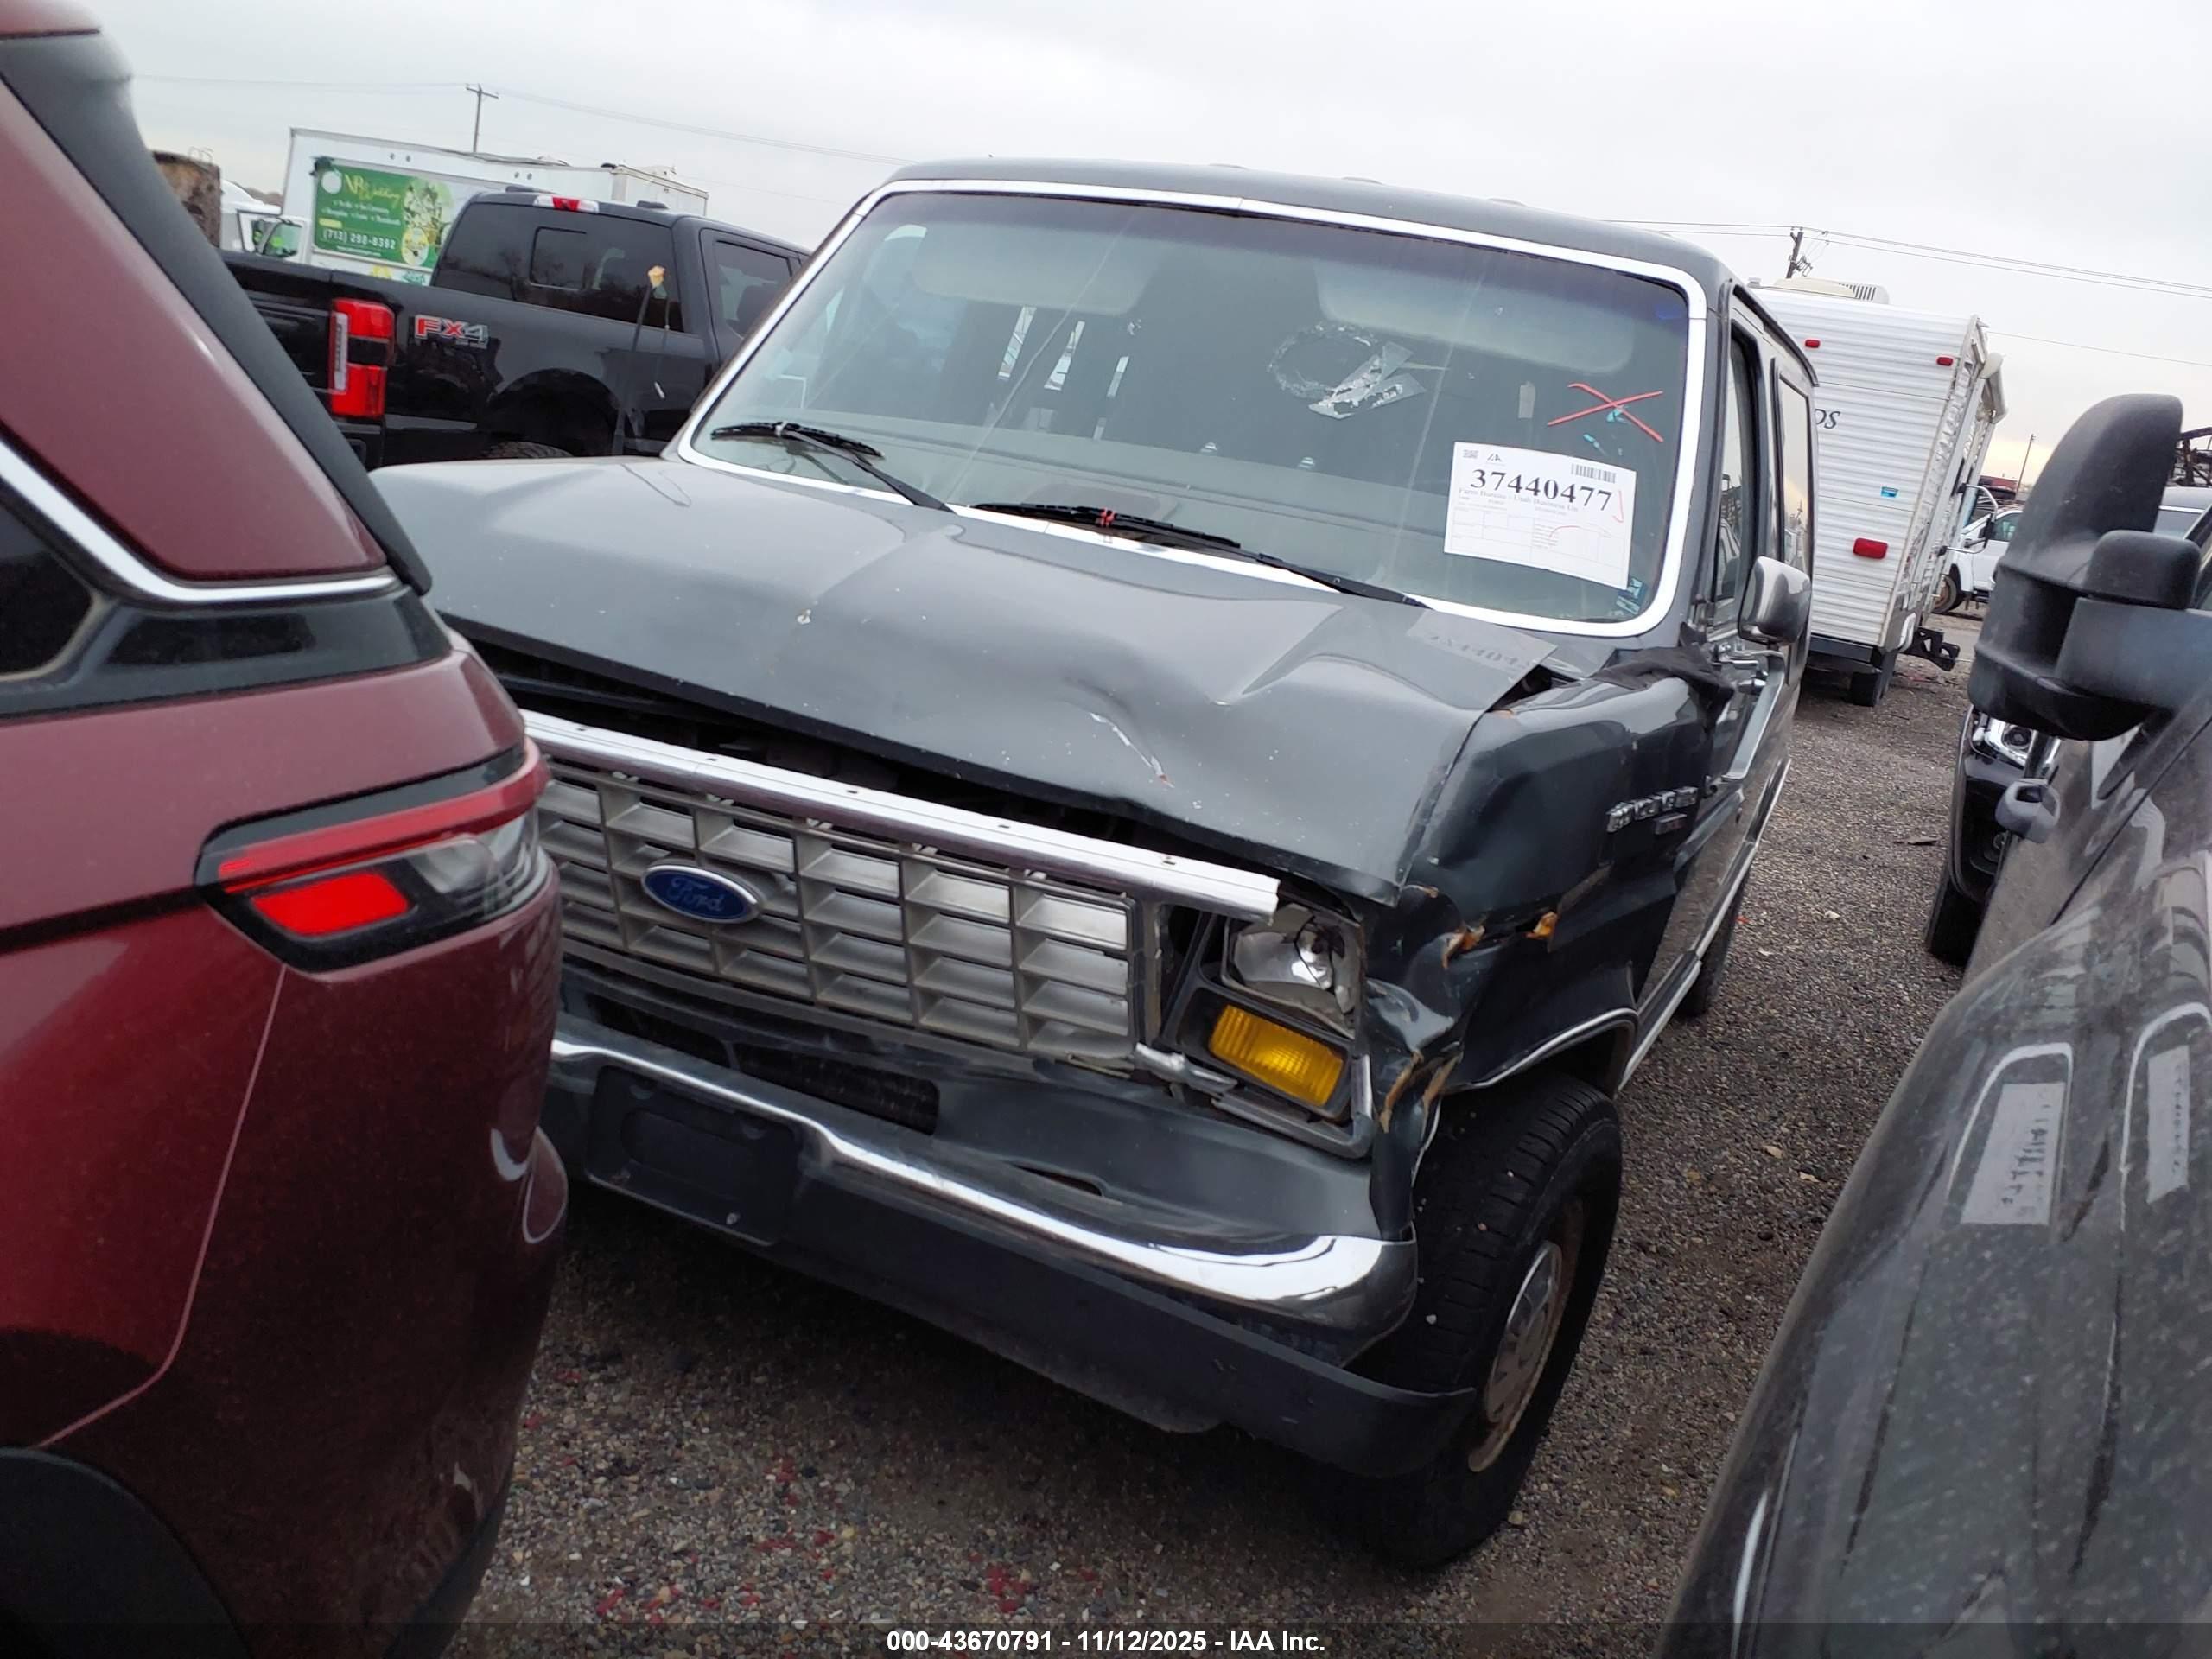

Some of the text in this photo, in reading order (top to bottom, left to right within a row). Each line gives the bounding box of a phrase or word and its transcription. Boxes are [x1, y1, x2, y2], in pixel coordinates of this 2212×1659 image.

[323, 228, 347, 242] (713)
[414, 314, 489, 342] FX4
[1470, 469, 1612, 512] 37440477
[666, 876, 725, 912] Ford
